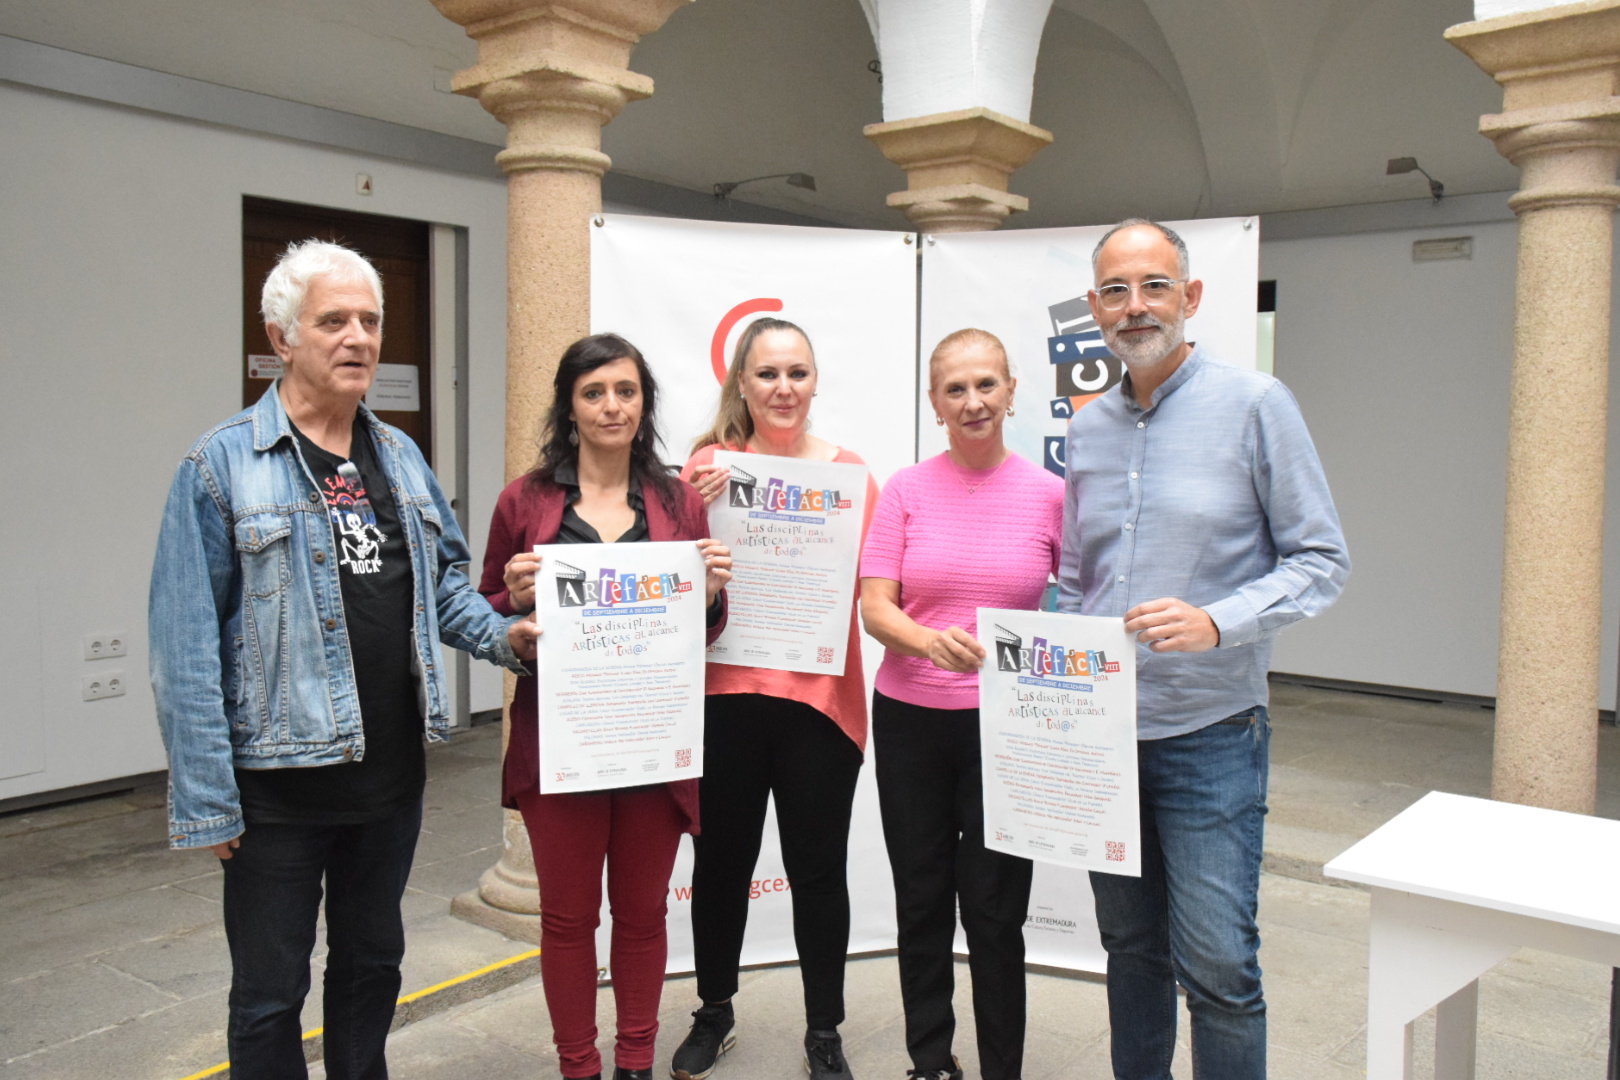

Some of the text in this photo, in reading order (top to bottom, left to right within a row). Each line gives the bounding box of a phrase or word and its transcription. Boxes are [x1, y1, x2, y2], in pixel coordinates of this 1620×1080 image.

[757, 512, 790, 521] SEPTIEMBRE
[351, 559, 381, 575] ROCK
[592, 608, 628, 616] SEPTIEMBRE
[634, 606, 665, 614] DICIEMBRE
[1093, 674, 1109, 682] 2024
[1026, 678, 1057, 687] SEPTIEMBRE
[1062, 683, 1091, 691] DICIEMBRE
[1036, 916, 1077, 928] EXTREMADURA
